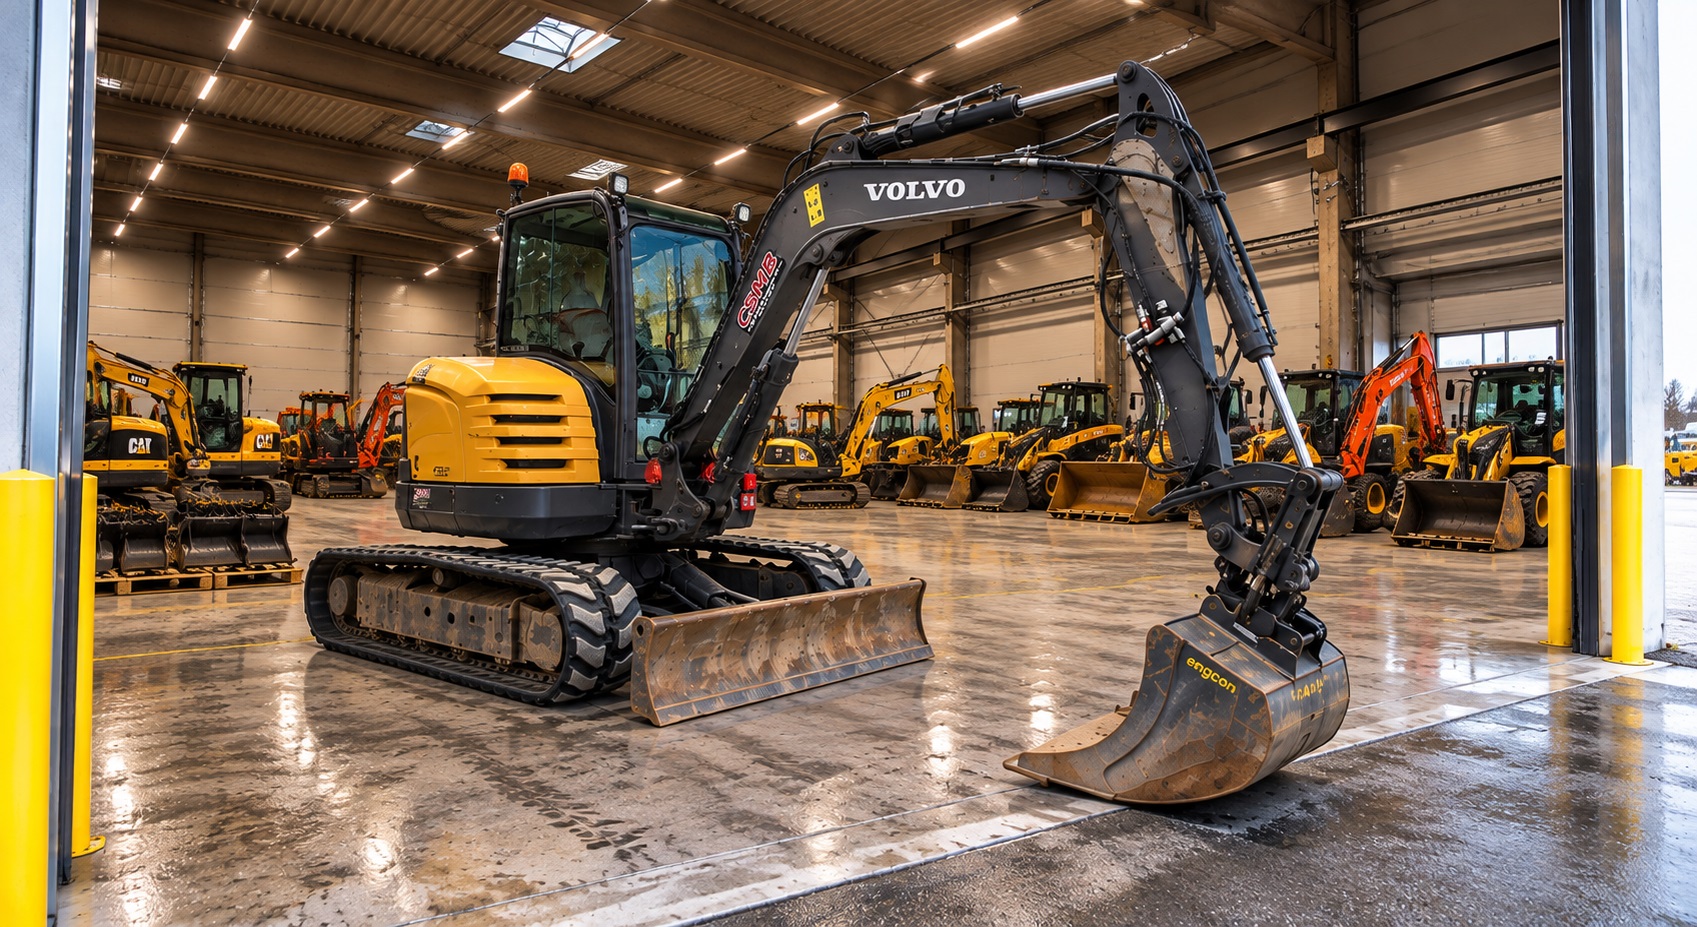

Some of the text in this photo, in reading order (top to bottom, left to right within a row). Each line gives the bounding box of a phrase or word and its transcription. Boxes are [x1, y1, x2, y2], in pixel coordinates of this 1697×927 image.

[863, 178, 966, 201] VOLVO
[737, 251, 778, 329] CSMB
[128, 437, 152, 455] CAT
[1186, 656, 1237, 694] engcon
